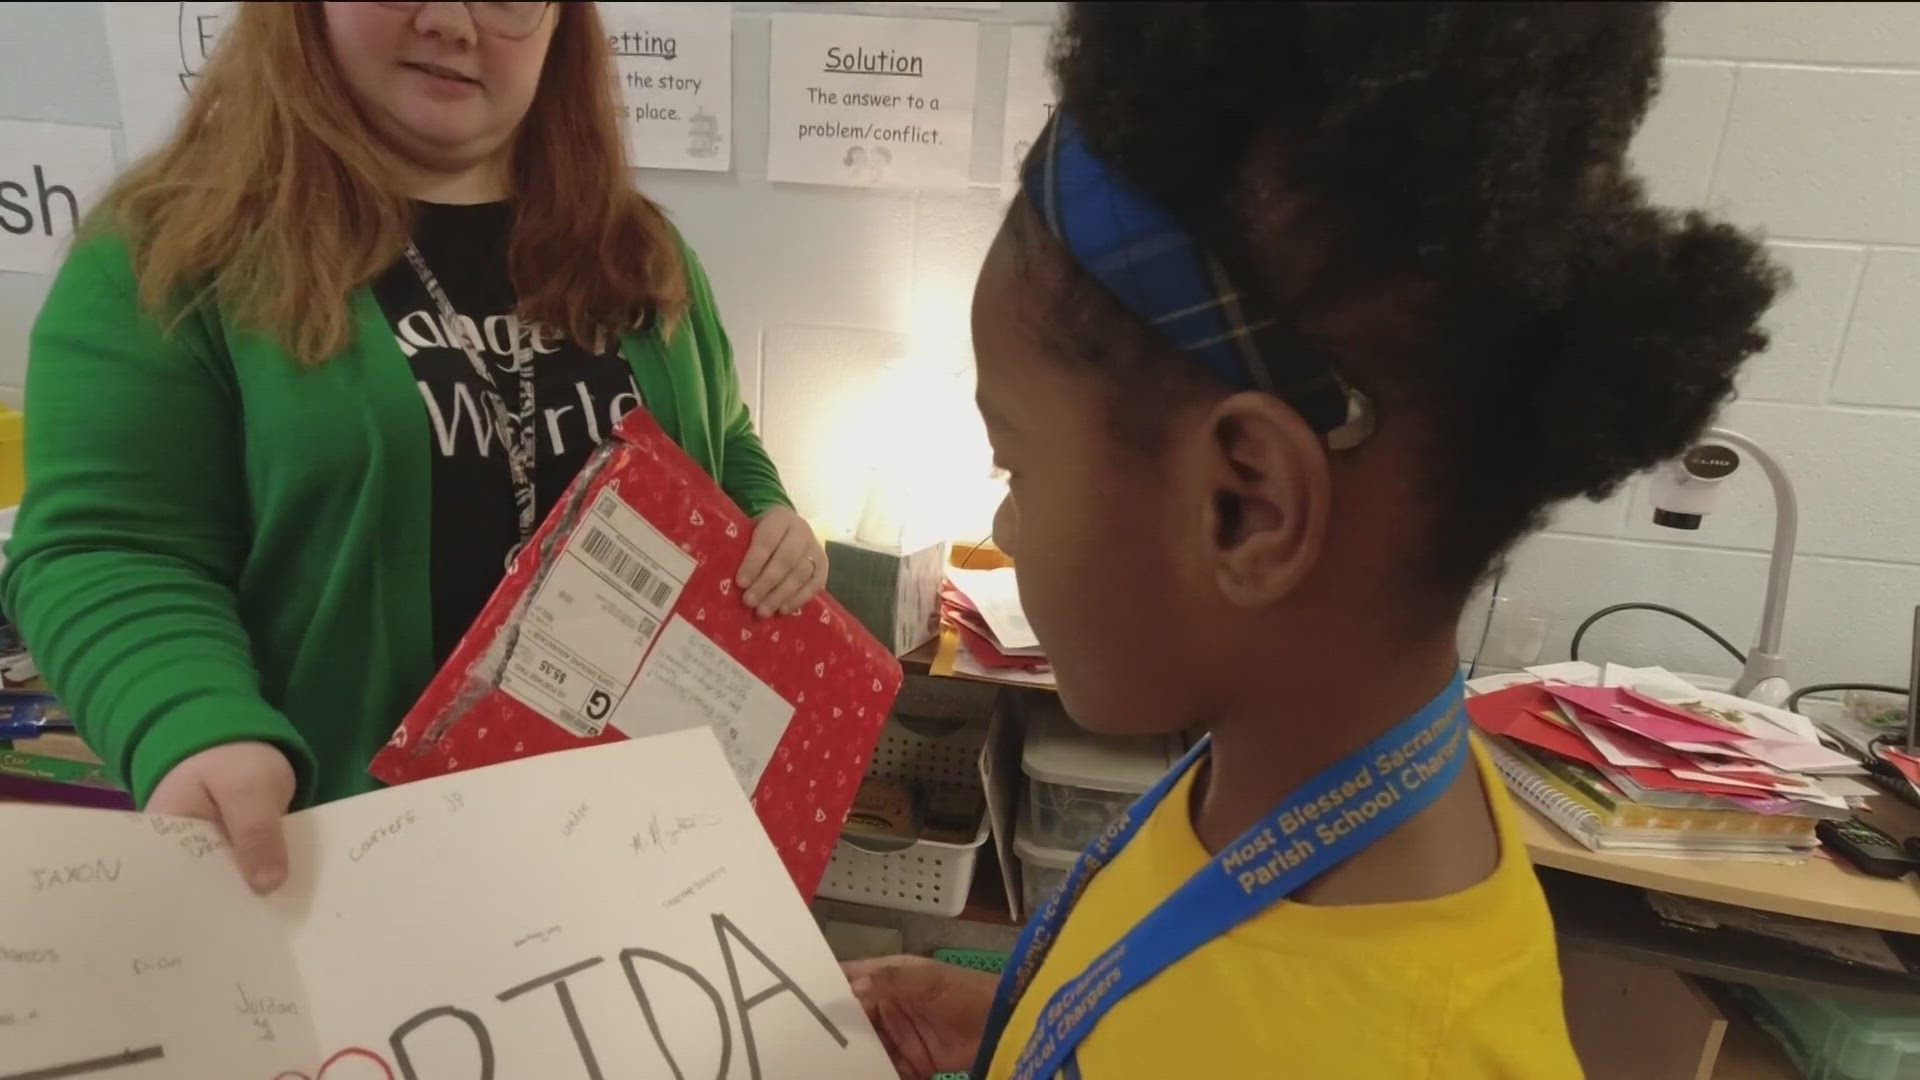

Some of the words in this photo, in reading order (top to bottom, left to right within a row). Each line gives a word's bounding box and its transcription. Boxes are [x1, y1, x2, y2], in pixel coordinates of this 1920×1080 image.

[608, 31, 677, 60] etting
[825, 46, 922, 76] Solution
[626, 72, 653, 88] the
[659, 74, 702, 95] story
[636, 103, 681, 124] place.
[807, 87, 838, 105] The
[842, 92, 902, 108] answer
[907, 94, 925, 110] to
[929, 98, 940, 111] a
[799, 121, 944, 145] problem/conflict.
[417, 373, 643, 458] Wrld
[538, 660, 567, 684] $5.35
[586, 689, 612, 720] G
[1222, 828, 1277, 875] Most
[1278, 766, 1373, 836] Blessed
[1238, 839, 1316, 895] Parish
[1315, 782, 1401, 846] School
